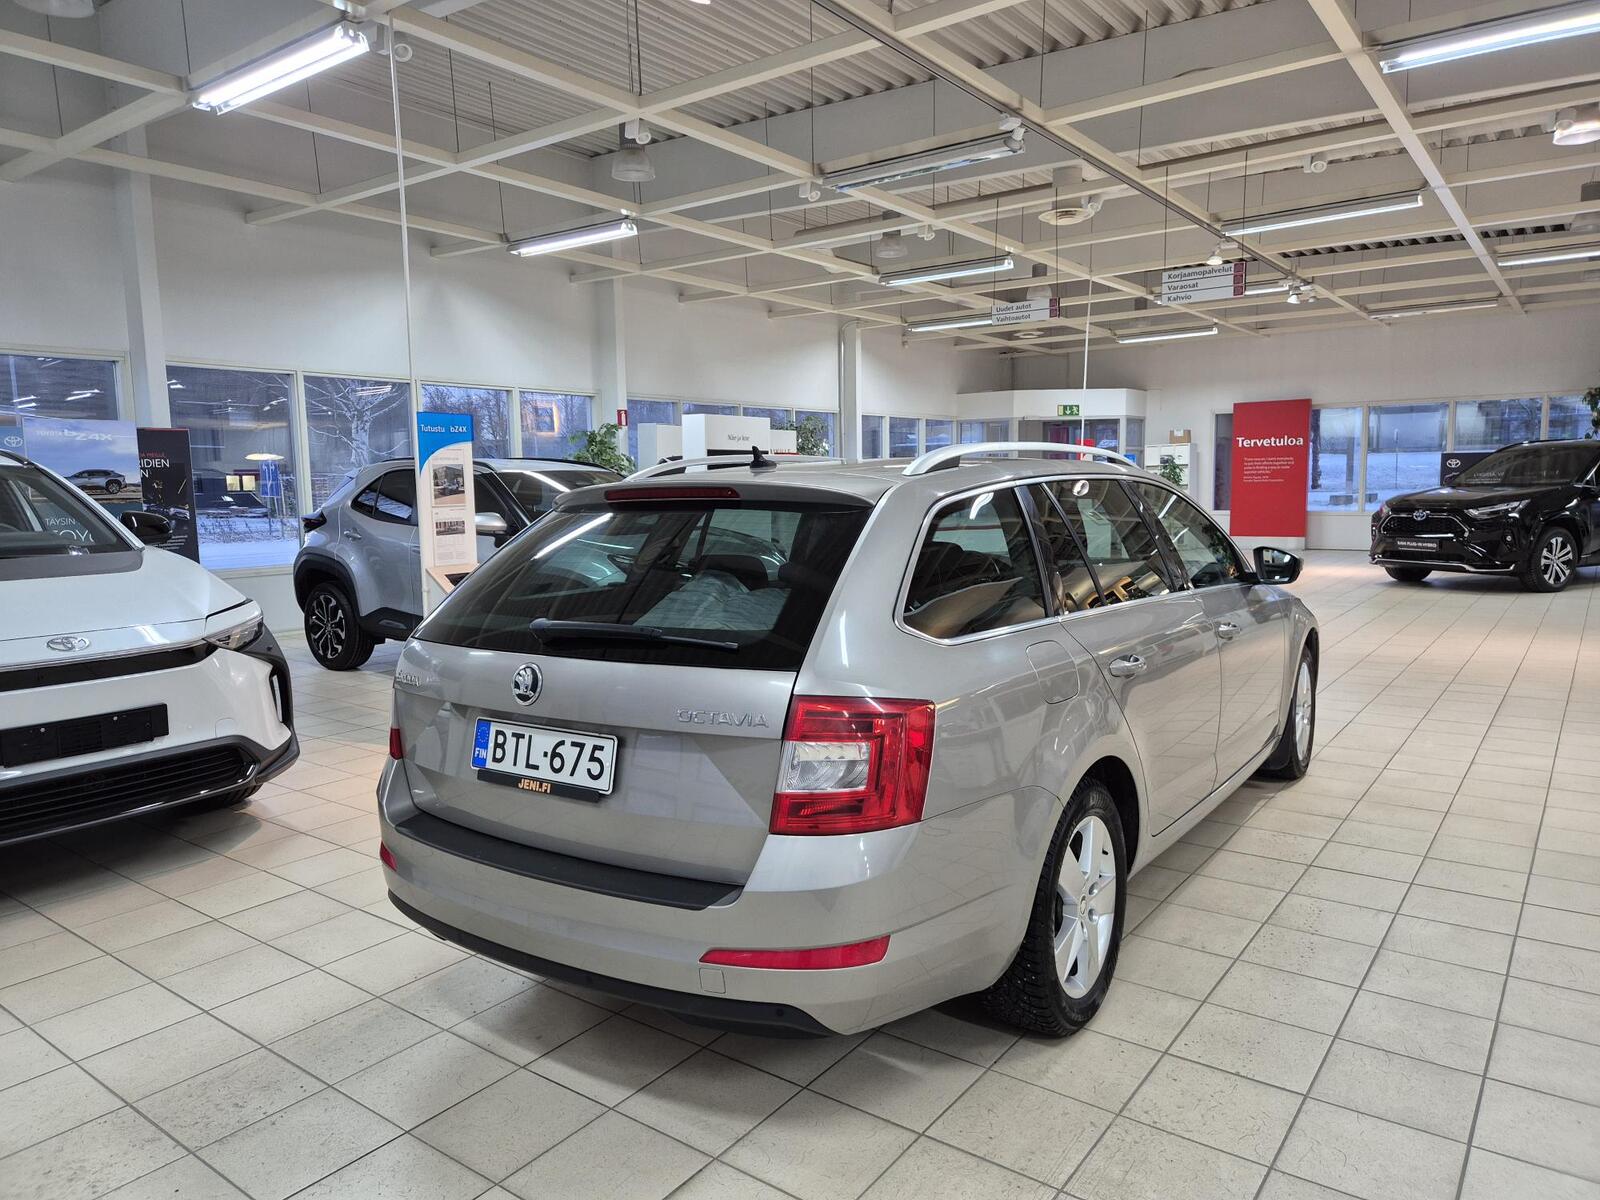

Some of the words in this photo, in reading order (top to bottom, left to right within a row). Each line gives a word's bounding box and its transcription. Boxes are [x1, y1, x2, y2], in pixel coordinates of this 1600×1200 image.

[1167, 266, 1233, 280] Korjaamopalvelut
[1167, 282, 1199, 291] Varaosat
[996, 314, 1031, 322] Vaihtoautot
[420, 424, 446, 433] Tutustu
[450, 425, 468, 433] bZ4X
[1236, 435, 1304, 448] Tervetuloa
[677, 708, 769, 729] OCTAVIA
[474, 747, 487, 759] FIN
[518, 778, 551, 794] JENI.FI
